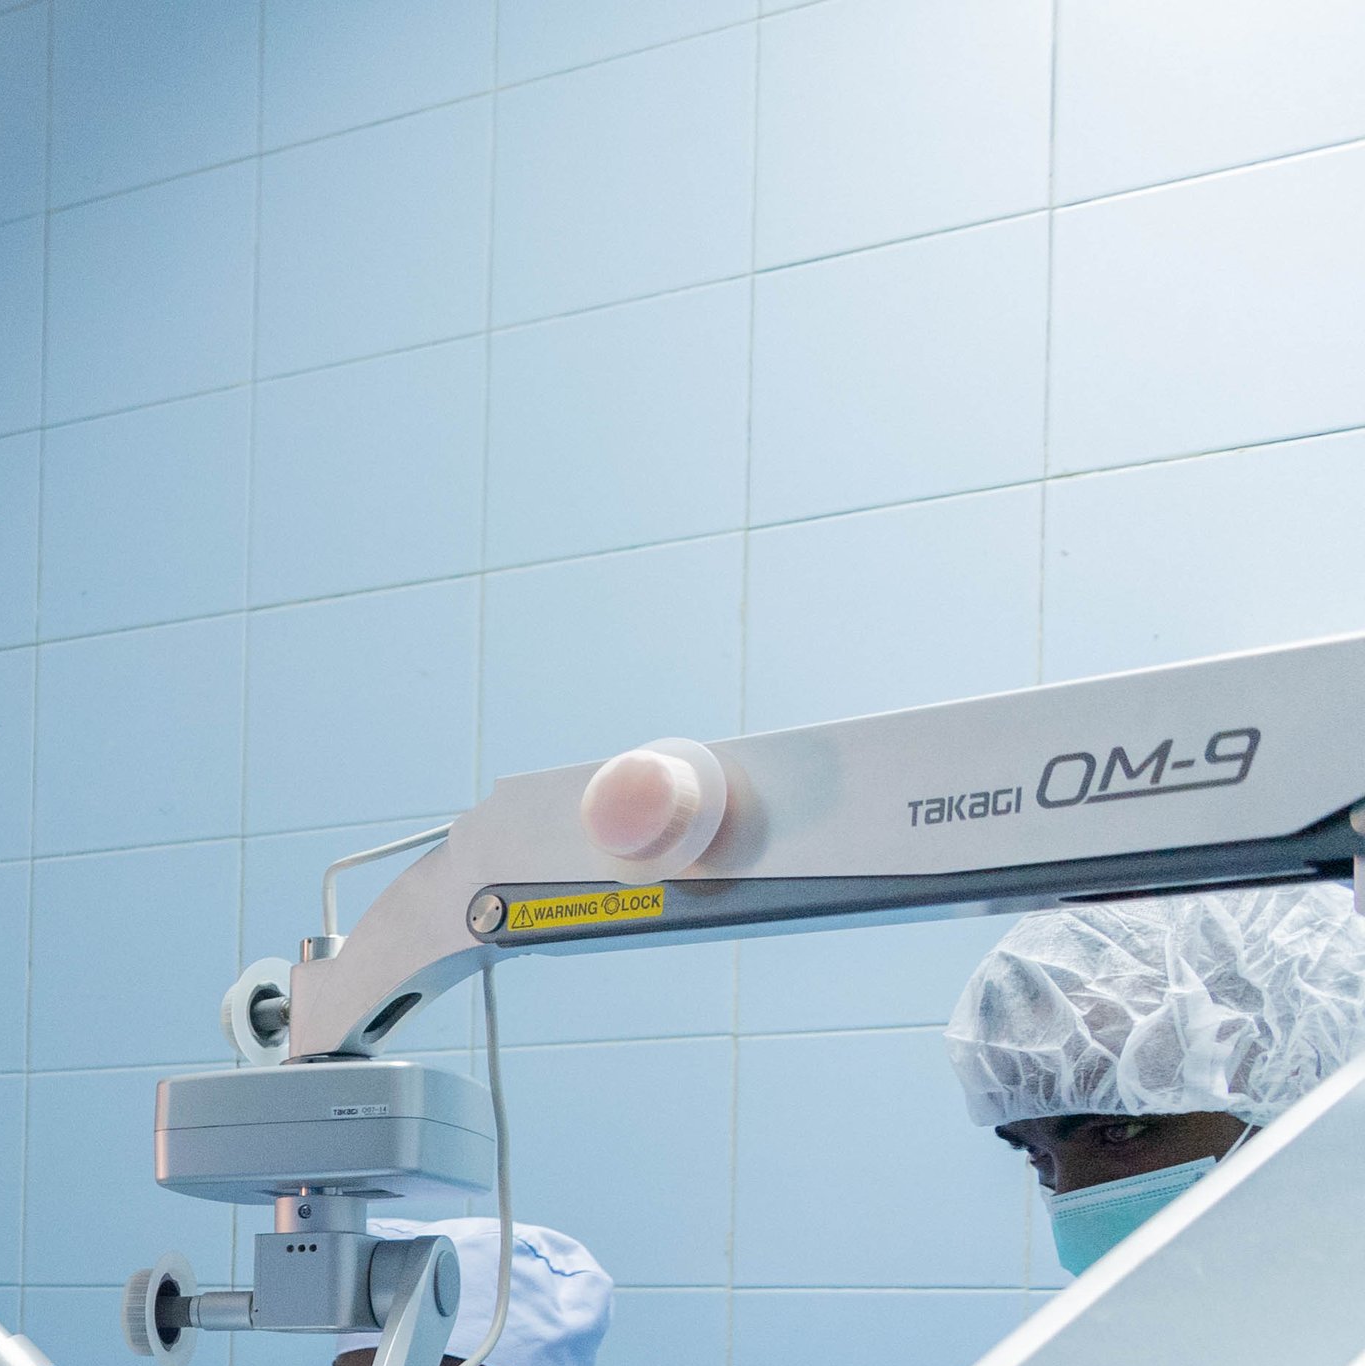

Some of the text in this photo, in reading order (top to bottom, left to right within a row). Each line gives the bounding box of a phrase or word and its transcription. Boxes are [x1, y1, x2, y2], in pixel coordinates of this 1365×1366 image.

[1035, 726, 1262, 810] OM-9
[533, 894, 661, 921] WARNING LOCK
